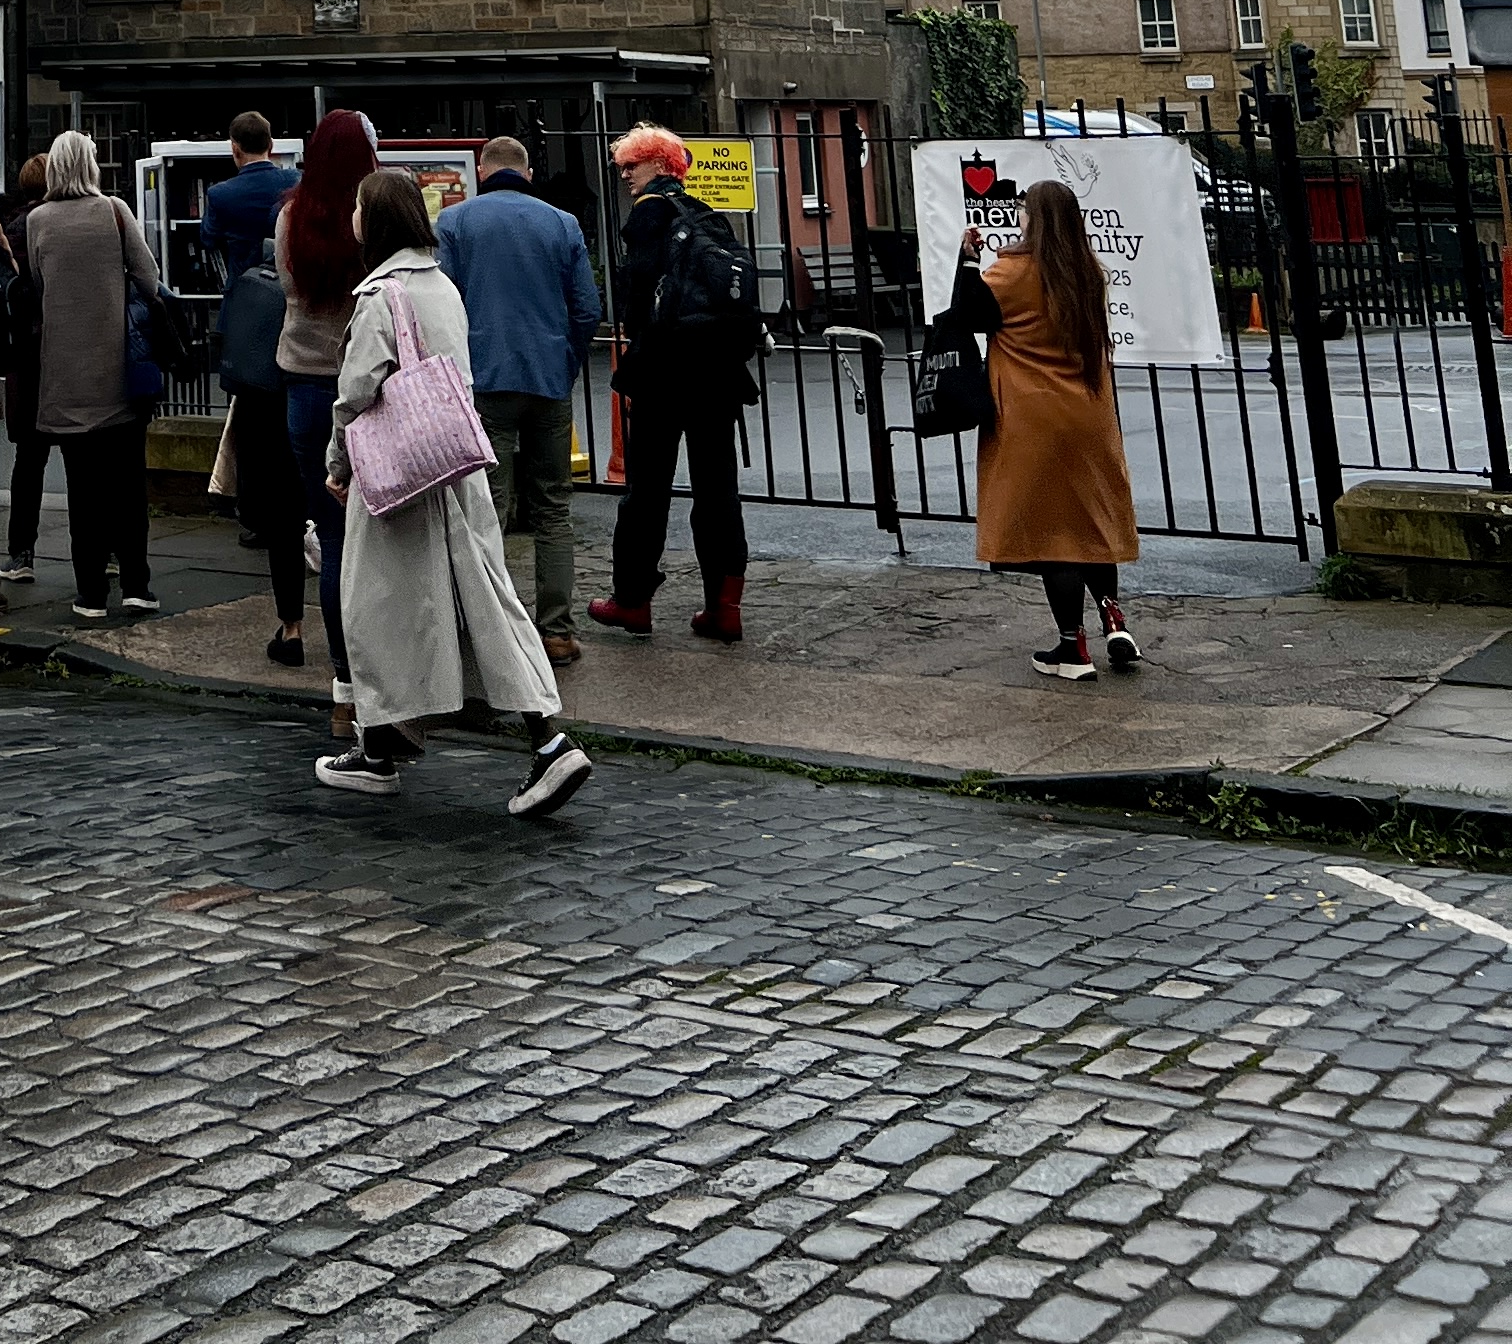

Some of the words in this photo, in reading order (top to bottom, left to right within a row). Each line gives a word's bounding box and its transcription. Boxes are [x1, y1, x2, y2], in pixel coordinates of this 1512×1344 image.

[713, 147, 730, 158] NO
[697, 160, 748, 171] PARKING
[965, 198, 984, 208] the
[985, 198, 1016, 208] heart
